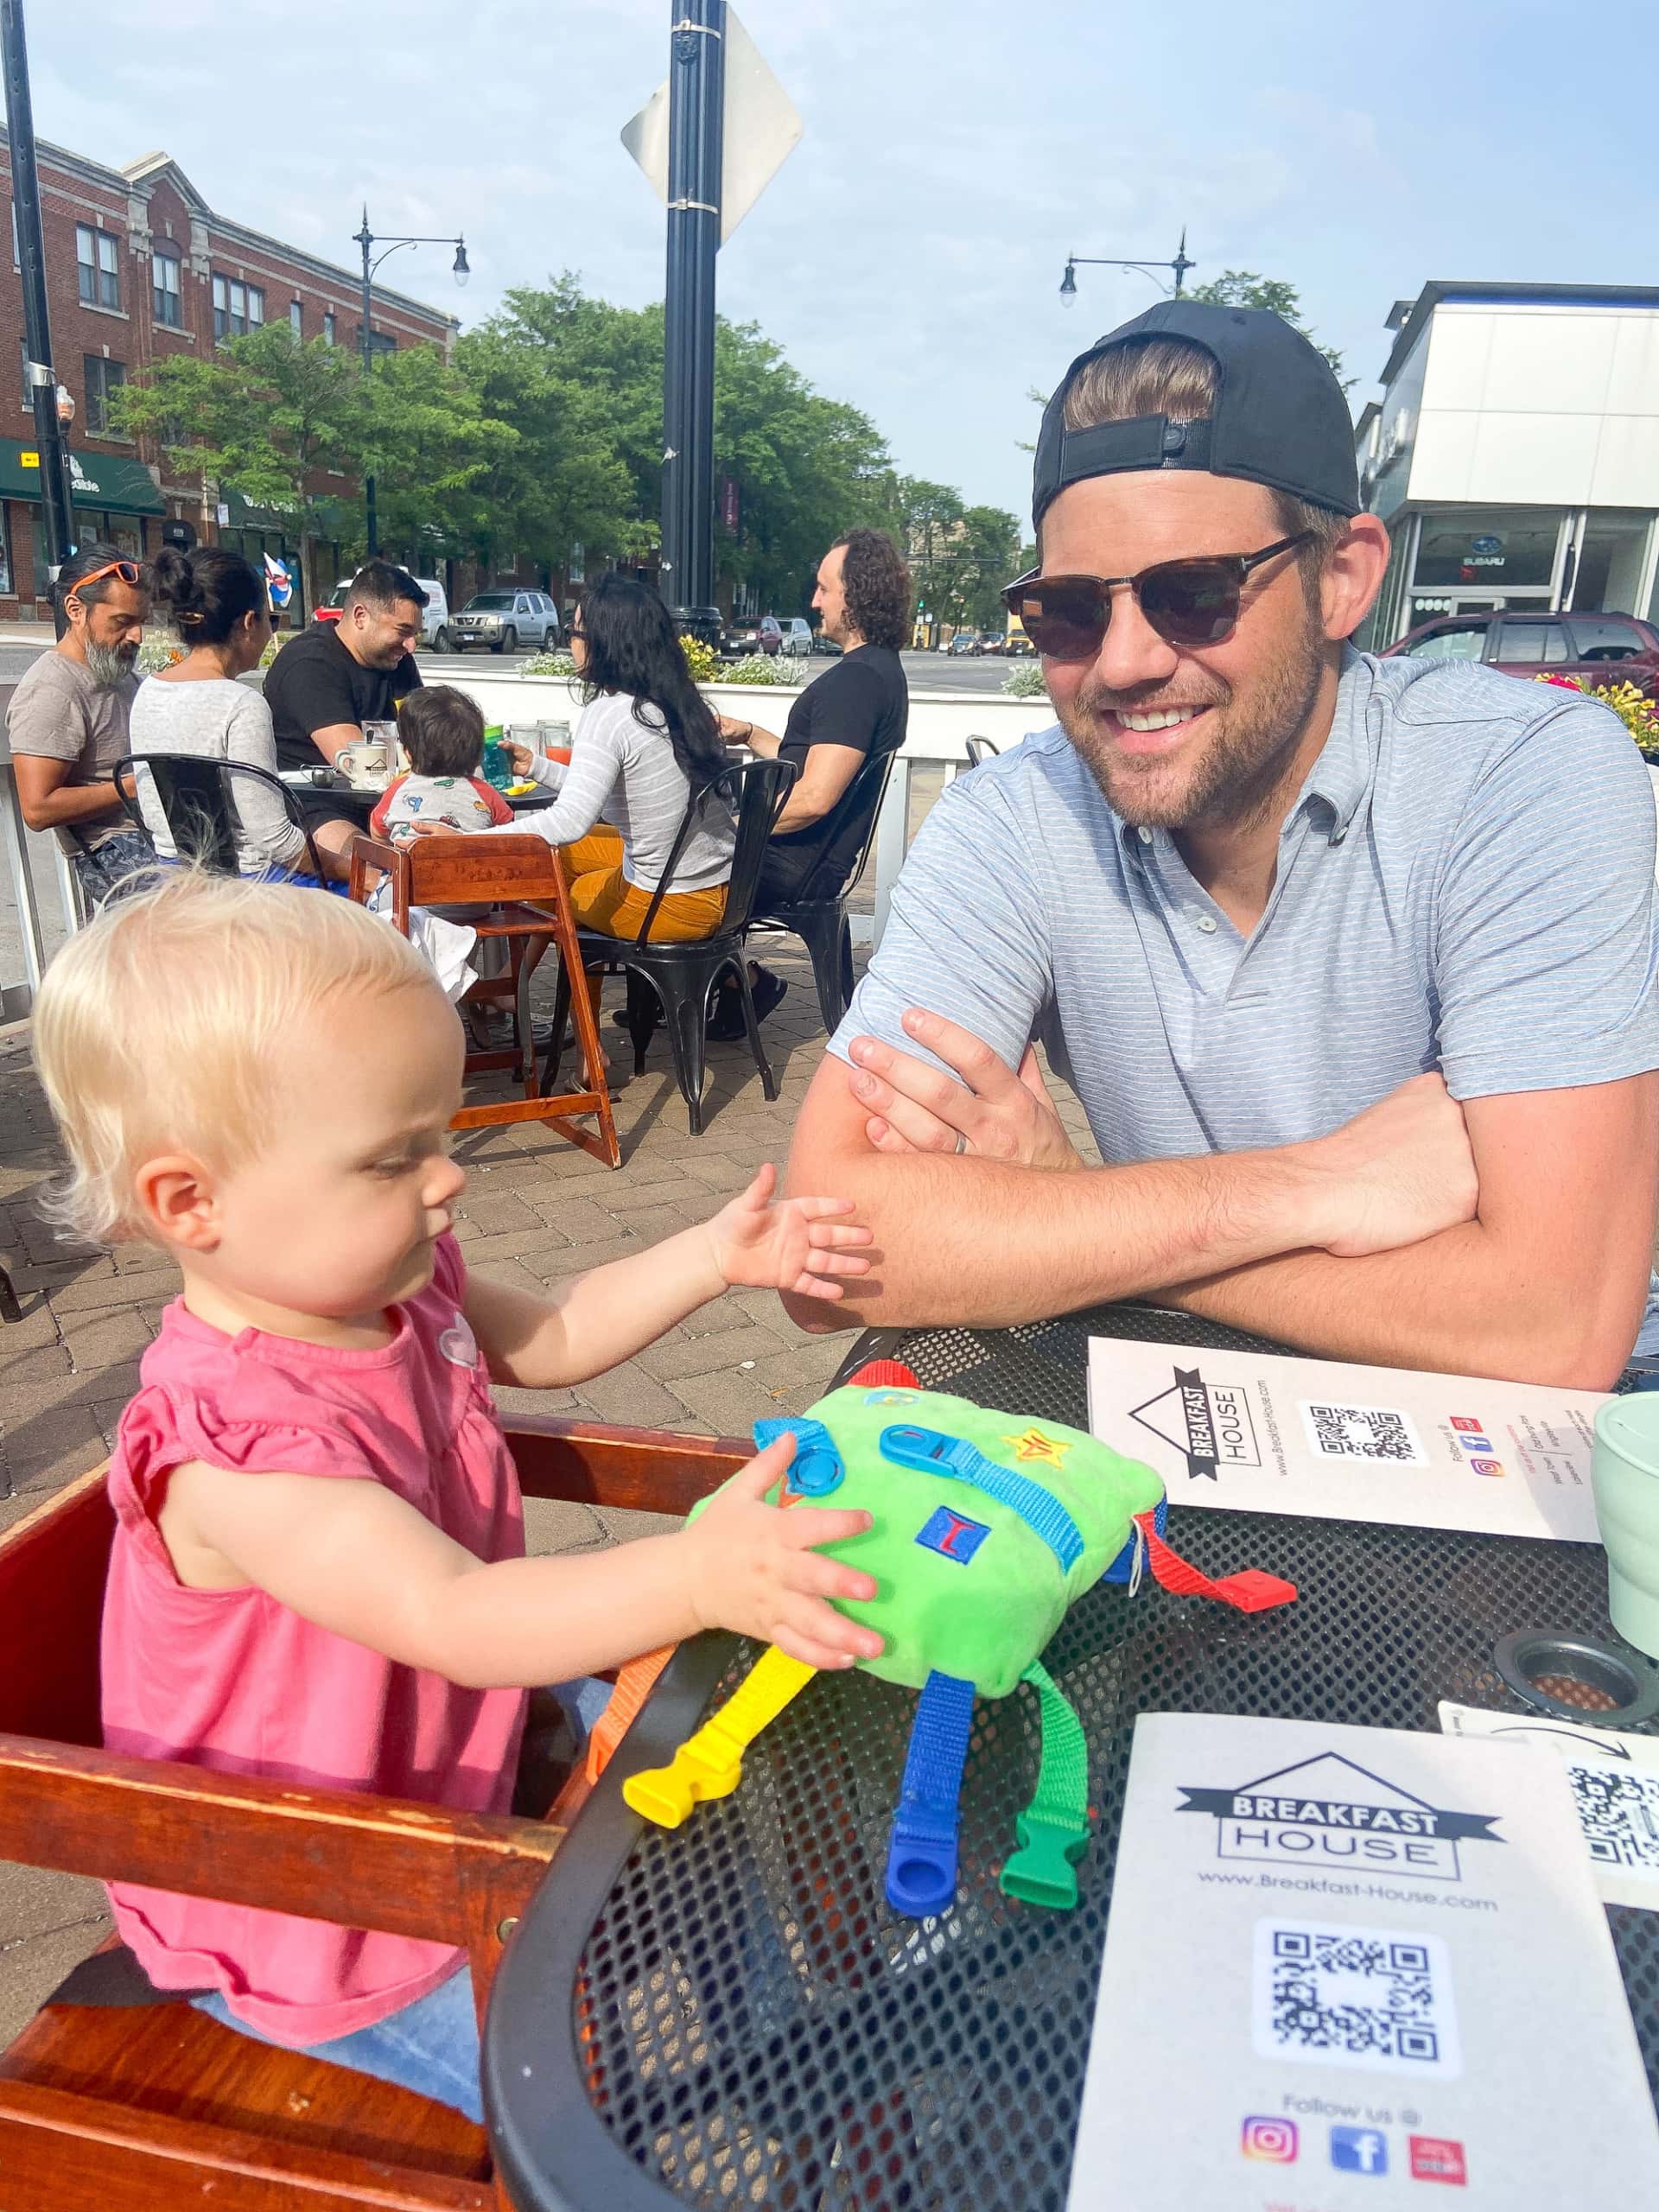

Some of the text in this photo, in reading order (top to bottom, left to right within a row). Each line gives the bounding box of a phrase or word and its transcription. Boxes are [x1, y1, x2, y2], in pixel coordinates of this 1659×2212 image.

[1463, 557, 1505, 566] SUBARU
[1183, 1386, 1216, 1458] BREAKFAST
[1215, 1391, 1247, 1459] HOUSE
[1257, 1380, 1287, 1476] www.Breakfast-House.com
[1447, 1440, 1465, 1462] Follow
[1232, 1796, 1439, 1835] BREAKFAST
[1236, 1827, 1439, 1866] HOUSE
[1198, 1871, 1499, 1912] www.Breakfast-House.com
[1283, 2093, 1361, 2119] Follow
[1366, 2107, 1394, 2125] us
